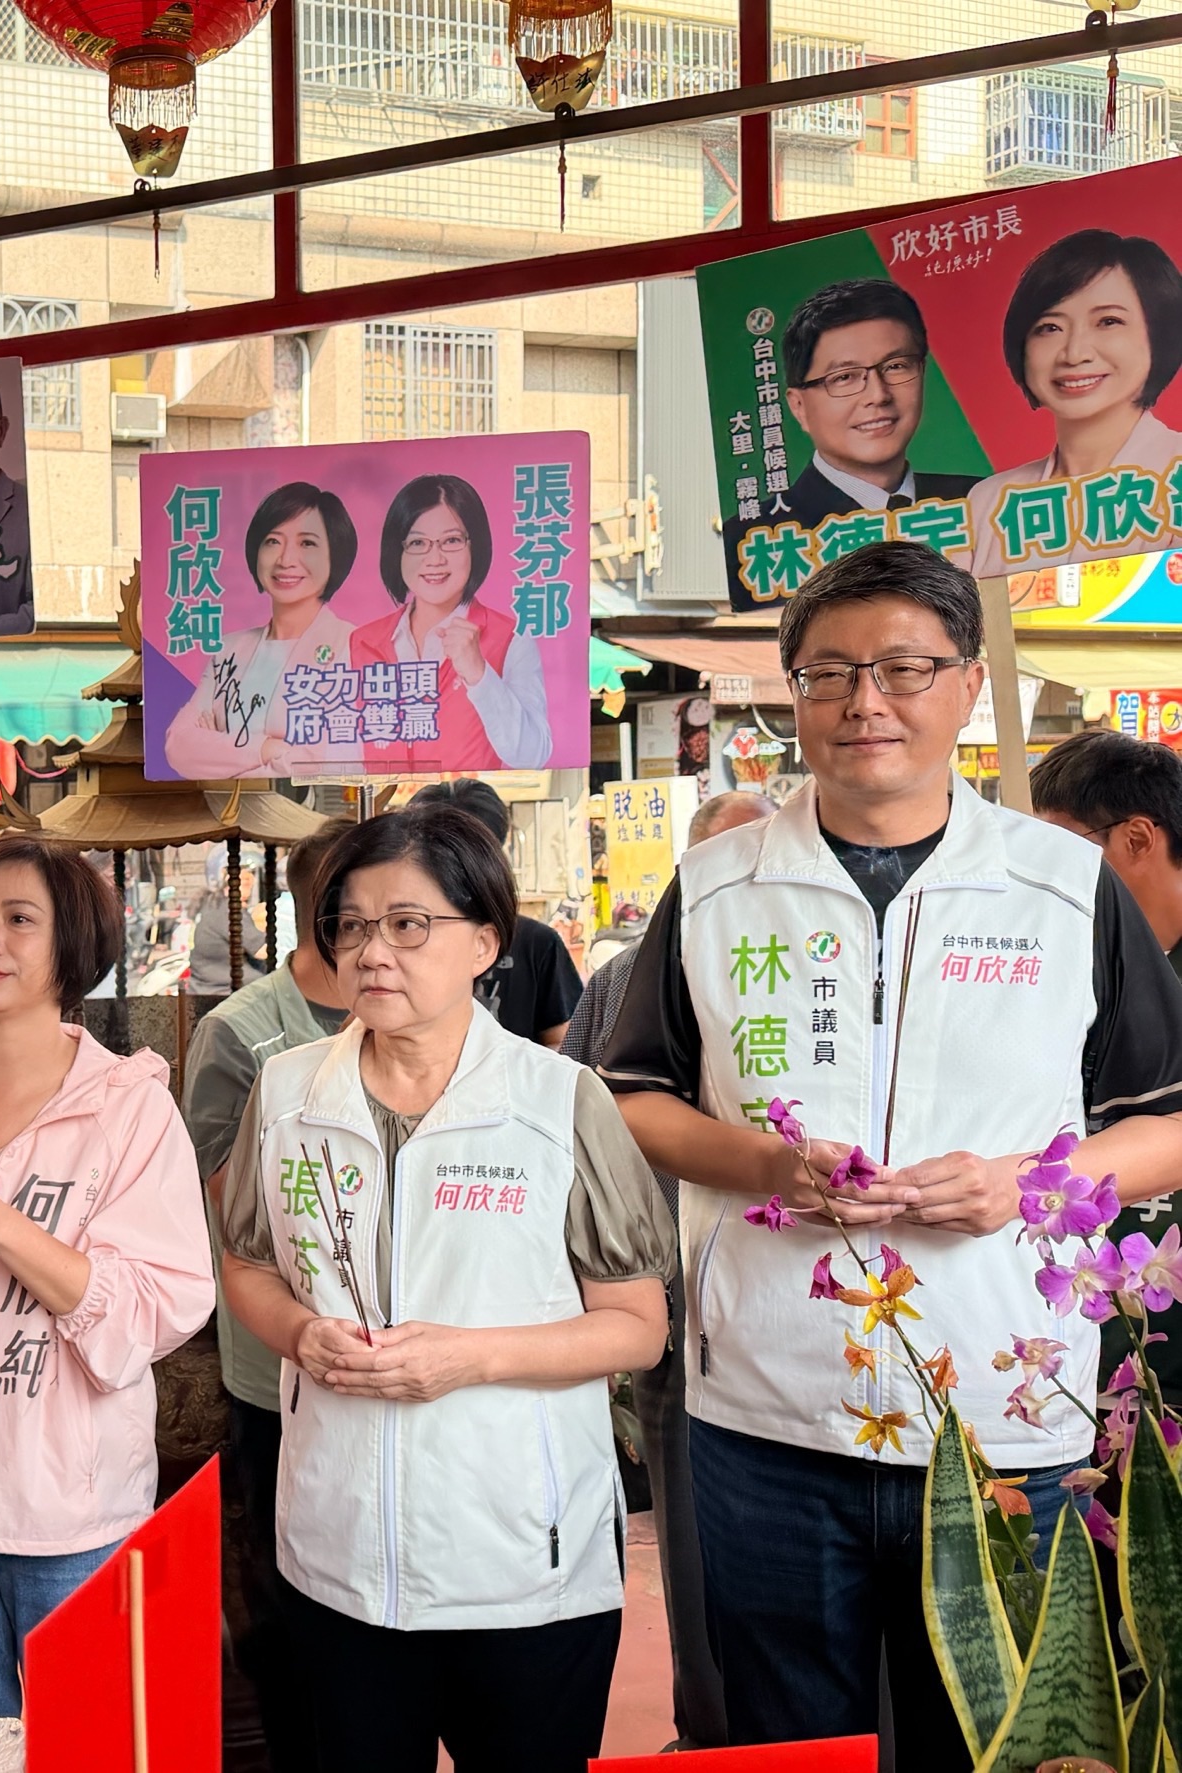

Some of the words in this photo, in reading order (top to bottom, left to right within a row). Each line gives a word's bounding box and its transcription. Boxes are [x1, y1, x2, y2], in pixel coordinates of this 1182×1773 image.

[889, 205, 1022, 266] 欣好市長
[752, 337, 791, 516] 台中市議員候選人
[994, 466, 1182, 564] 何欣
[165, 484, 225, 656] 何欣純
[514, 462, 574, 638] 張芬郁
[283, 661, 439, 704] 女力出頭
[283, 702, 440, 745] 府會雙贏
[940, 952, 1043, 986] 何欣純
[942, 934, 1044, 953] 台中市長候選人
[811, 976, 838, 1066] 市議員
[433, 1182, 528, 1215] 何欣純
[436, 1163, 529, 1182] 台中市長候選人
